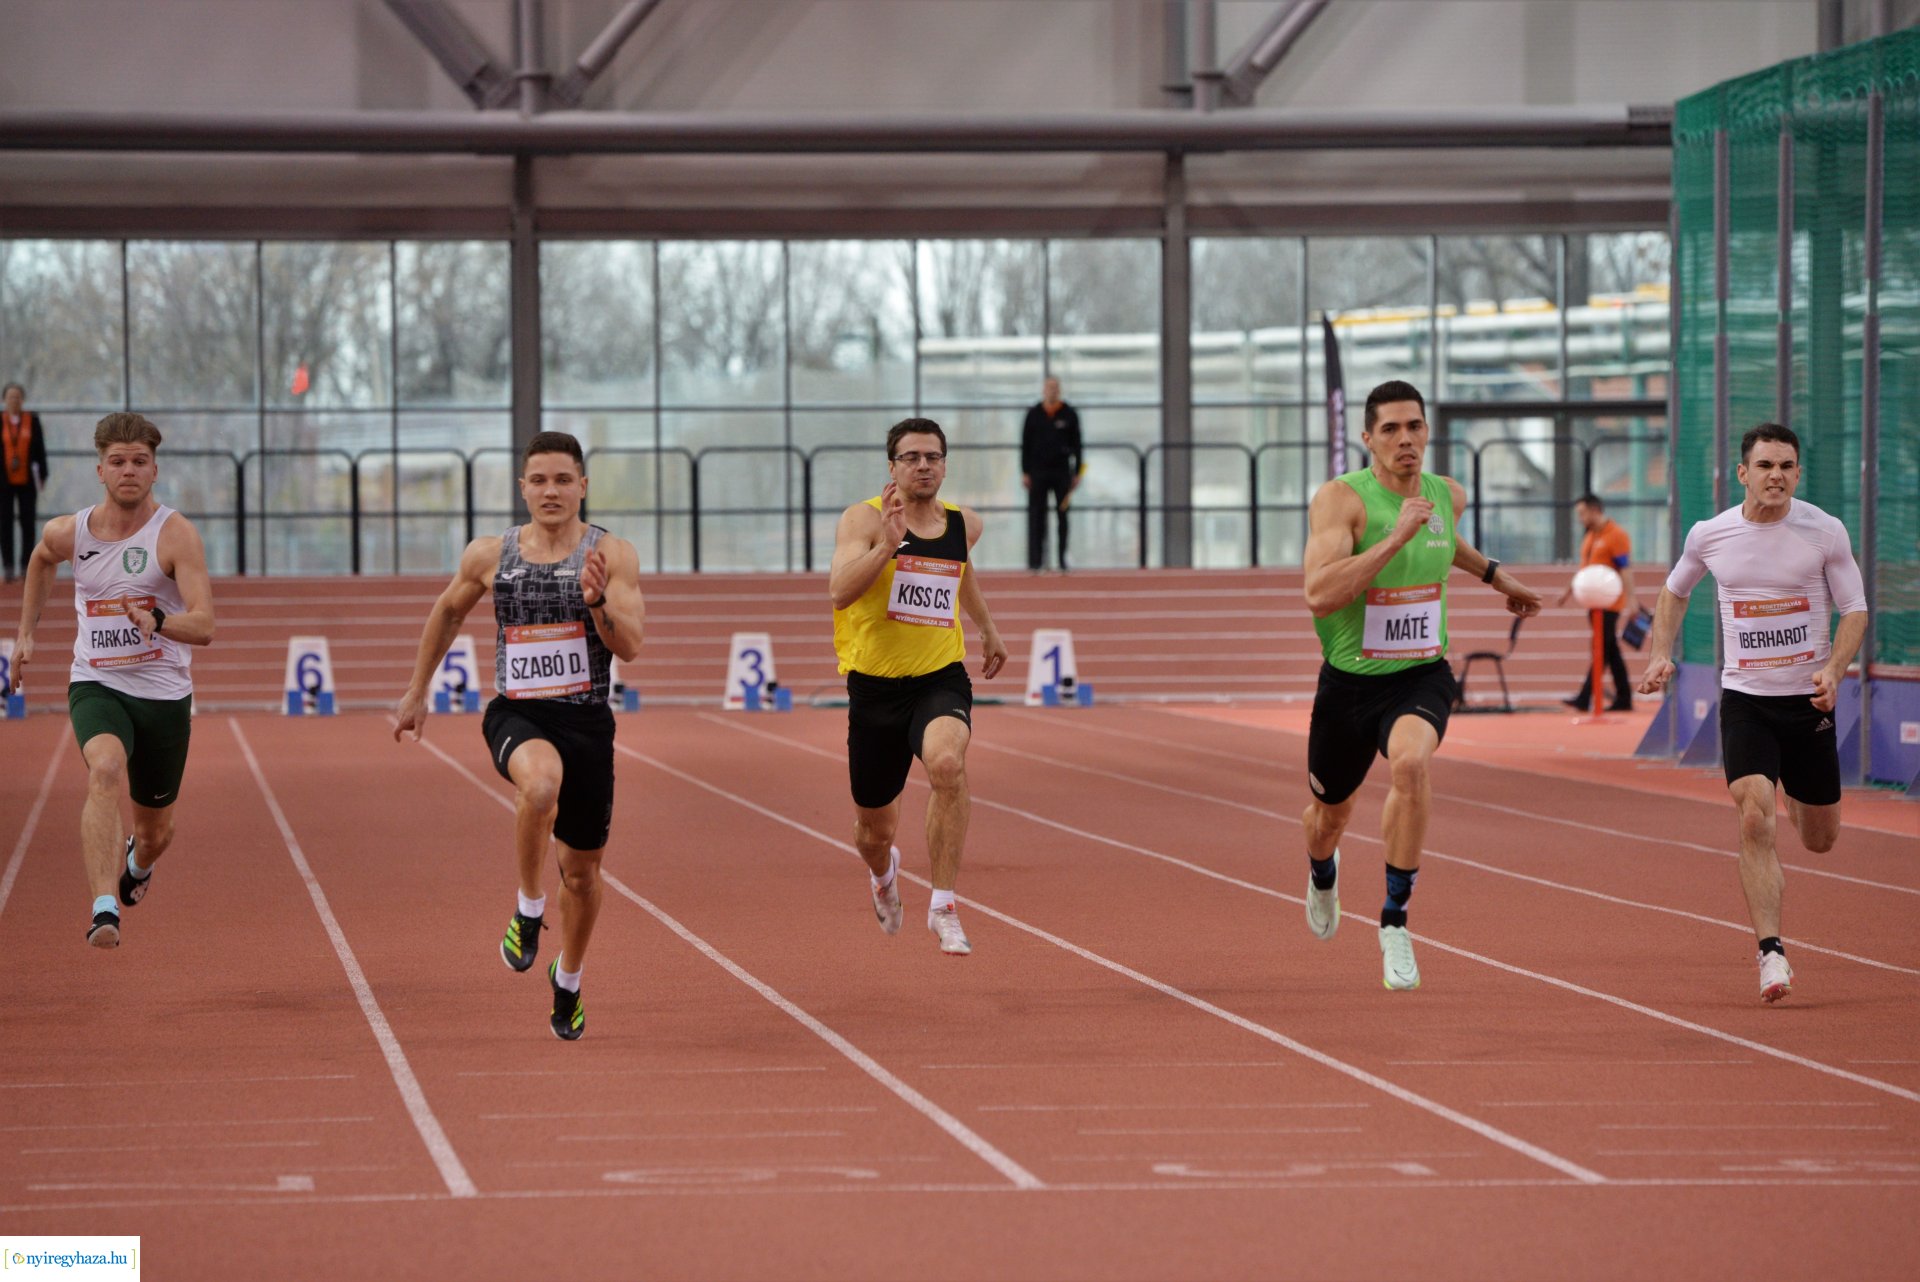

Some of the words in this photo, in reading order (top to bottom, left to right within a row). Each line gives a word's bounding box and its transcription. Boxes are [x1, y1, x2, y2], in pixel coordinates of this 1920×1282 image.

[897, 583, 933, 608] KISS
[934, 588, 951, 610] CS.
[91, 627, 141, 649] FARKAS
[1385, 611, 1429, 641] MÁTÉ
[1738, 624, 1808, 649] IBERHARDT
[296, 653, 323, 694] 6
[442, 651, 469, 692] 5
[511, 649, 565, 680] SZABÓ
[569, 652, 586, 675] D.
[740, 649, 765, 689] 3
[1042, 646, 1062, 687] 1
